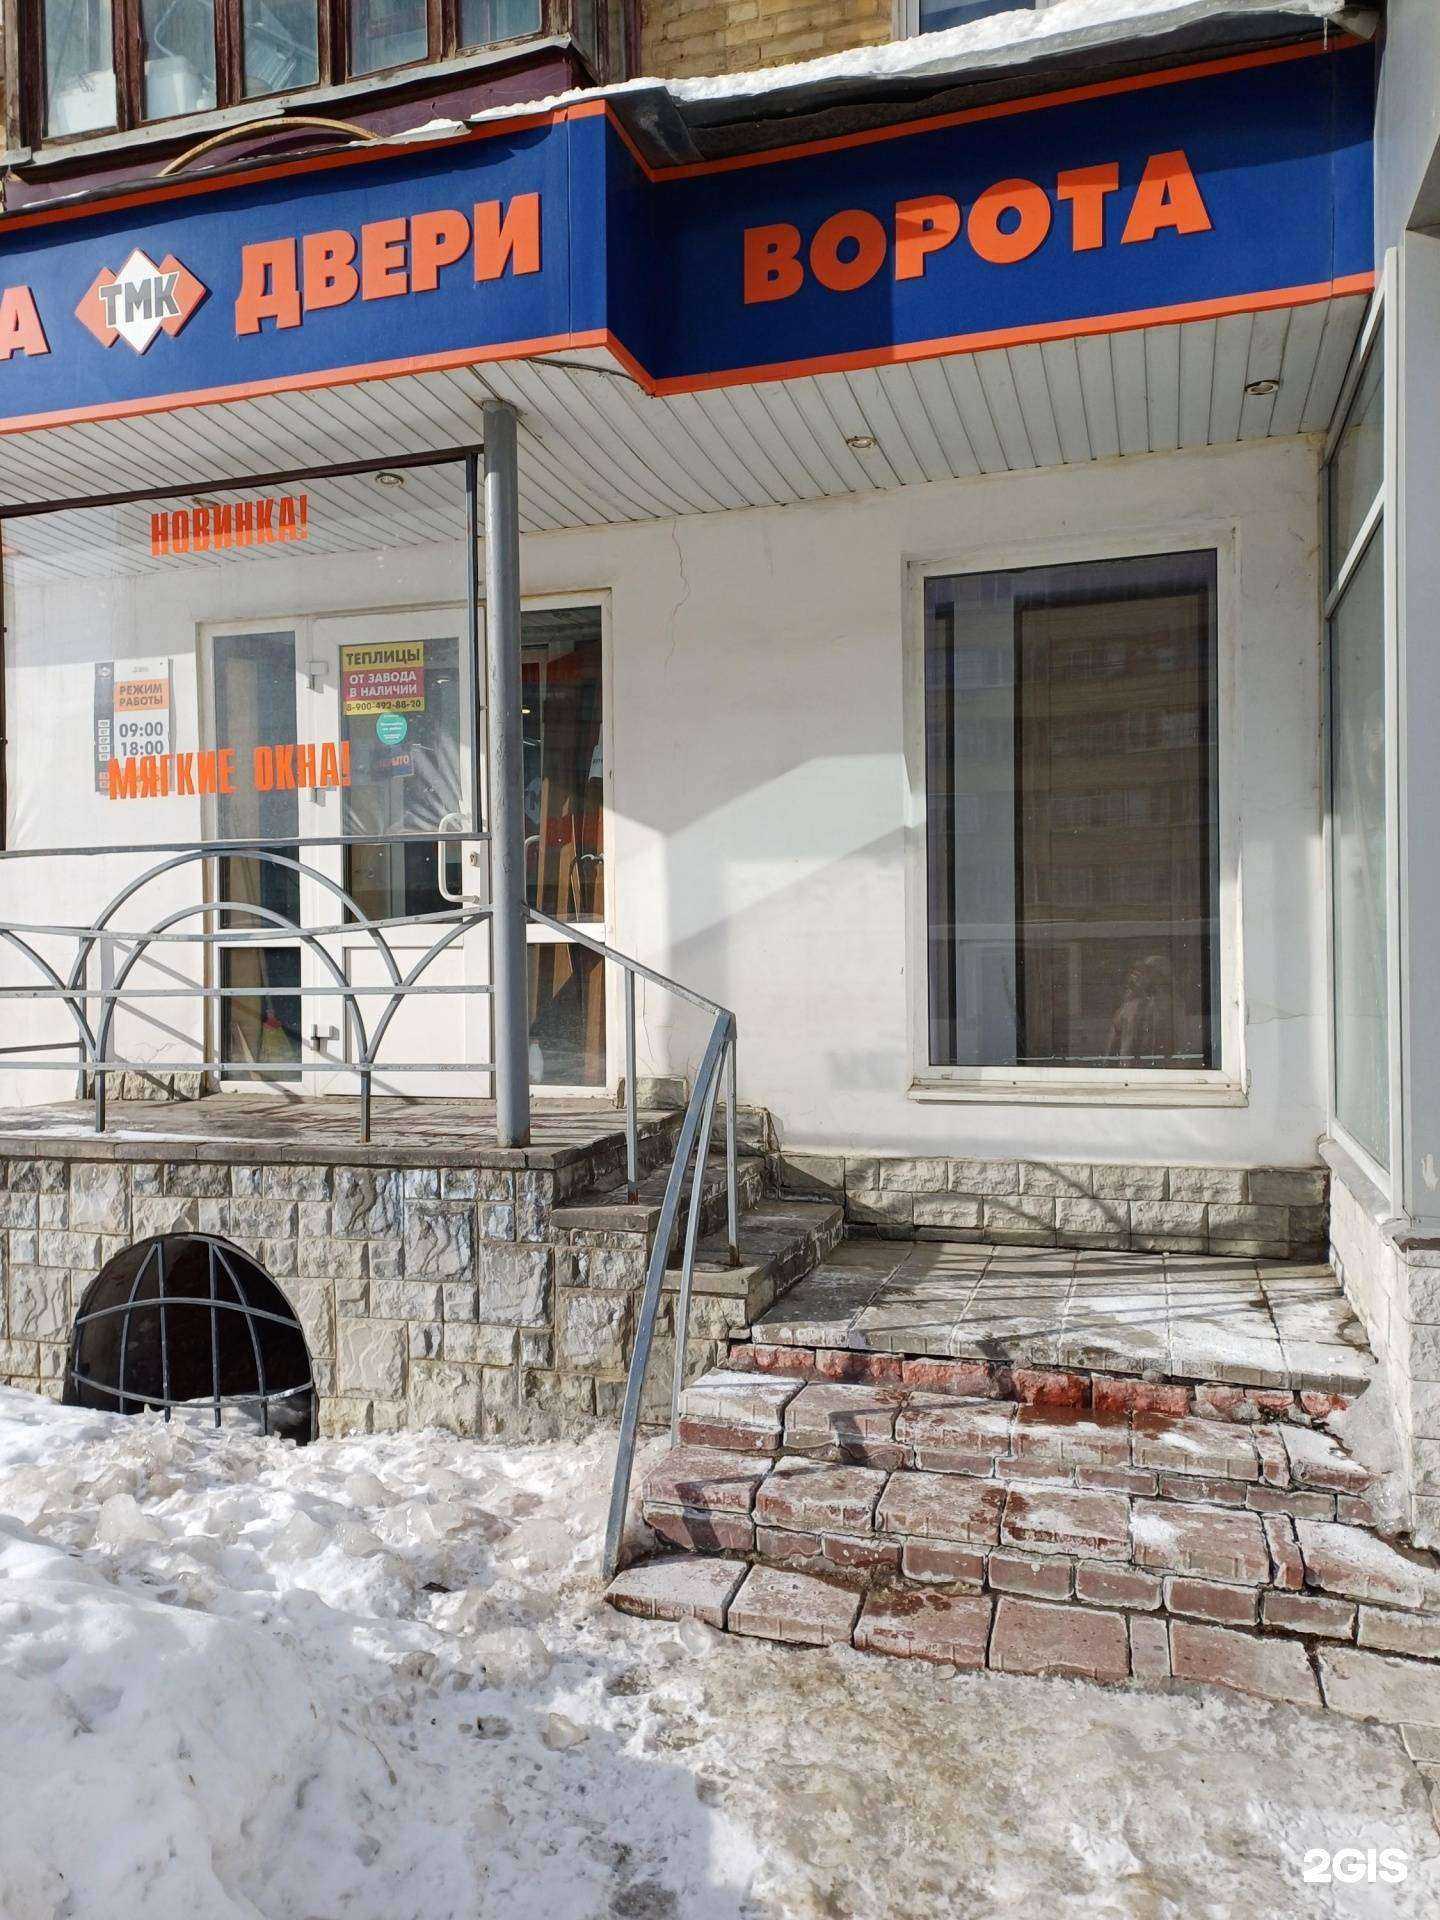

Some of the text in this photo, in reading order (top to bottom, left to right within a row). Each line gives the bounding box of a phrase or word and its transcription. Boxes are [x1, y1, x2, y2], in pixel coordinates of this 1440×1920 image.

[744, 150, 1212, 304] ВОРОТА
[235, 193, 541, 336] ДВЕРИ
[100, 273, 180, 327] ТМК
[151, 494, 309, 558] НОВИНКА!
[346, 648, 420, 666] ТЕПЛИЦЫ
[349, 670, 417, 685] ОТ ЗАВОДА
[120, 682, 162, 696] РЕЖИМ
[349, 684, 417, 698] В НАЛИЧИИ
[120, 695, 163, 707] РАБОТЫ
[119, 721, 164, 738] 09:00
[121, 740, 164, 757] 18:00
[109, 741, 350, 800] МЯГКИЕ ОКНА!
